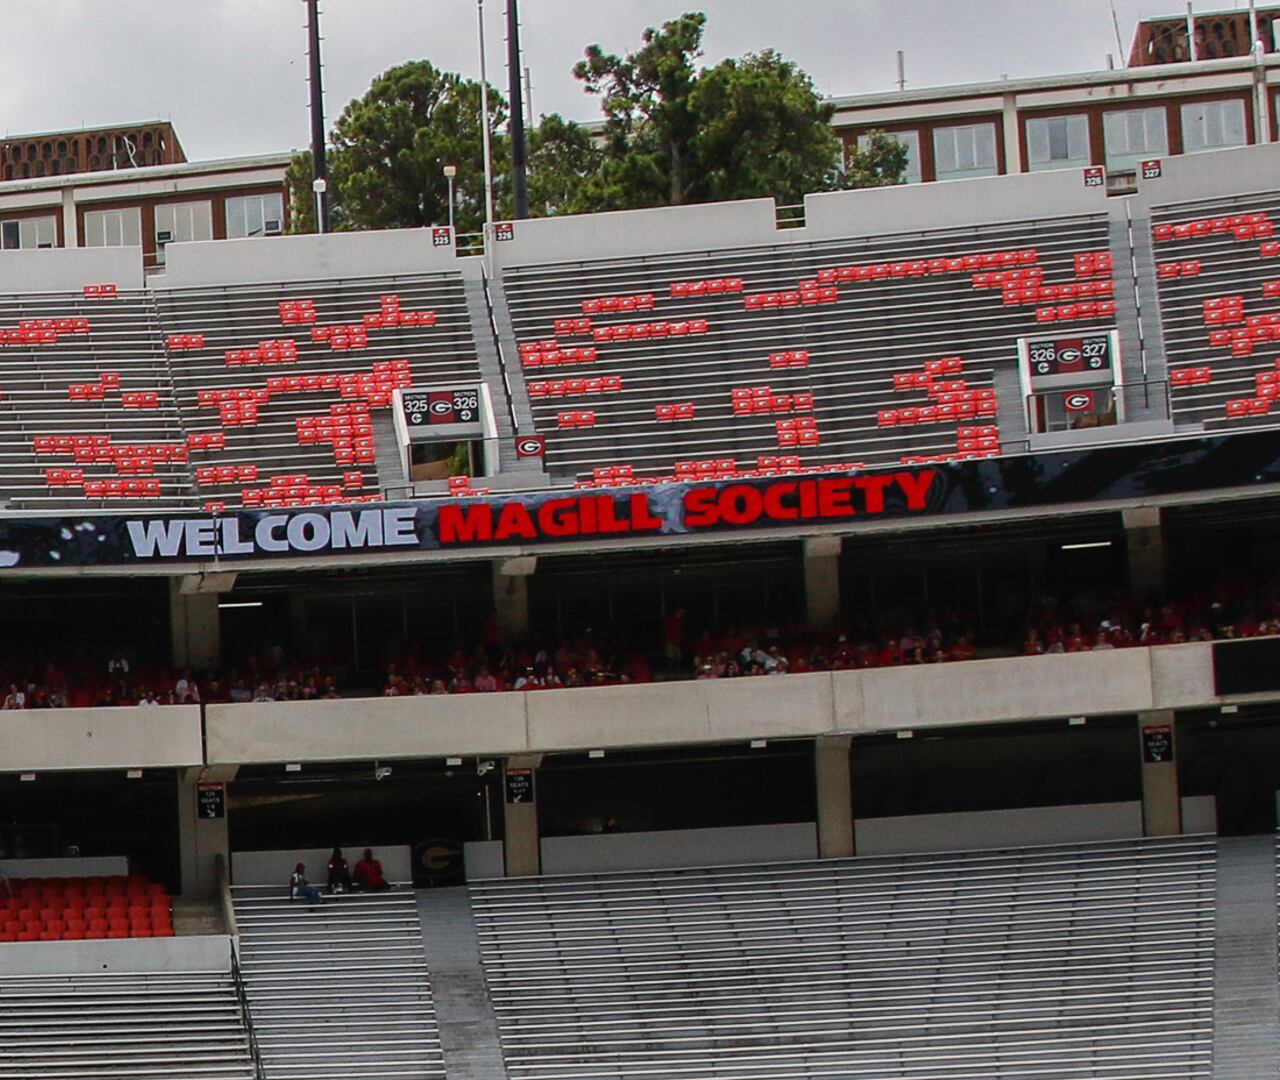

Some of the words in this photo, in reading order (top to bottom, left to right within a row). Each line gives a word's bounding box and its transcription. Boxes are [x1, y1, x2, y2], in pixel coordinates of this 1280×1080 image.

[1030, 348, 1055, 362] 326
[1082, 343, 1107, 357] 327
[404, 401, 428, 413] 325
[453, 397, 477, 409] 326
[126, 507, 420, 557] WELCOME
[439, 493, 663, 543] MAGILL
[683, 470, 937, 527] SOCIETY
